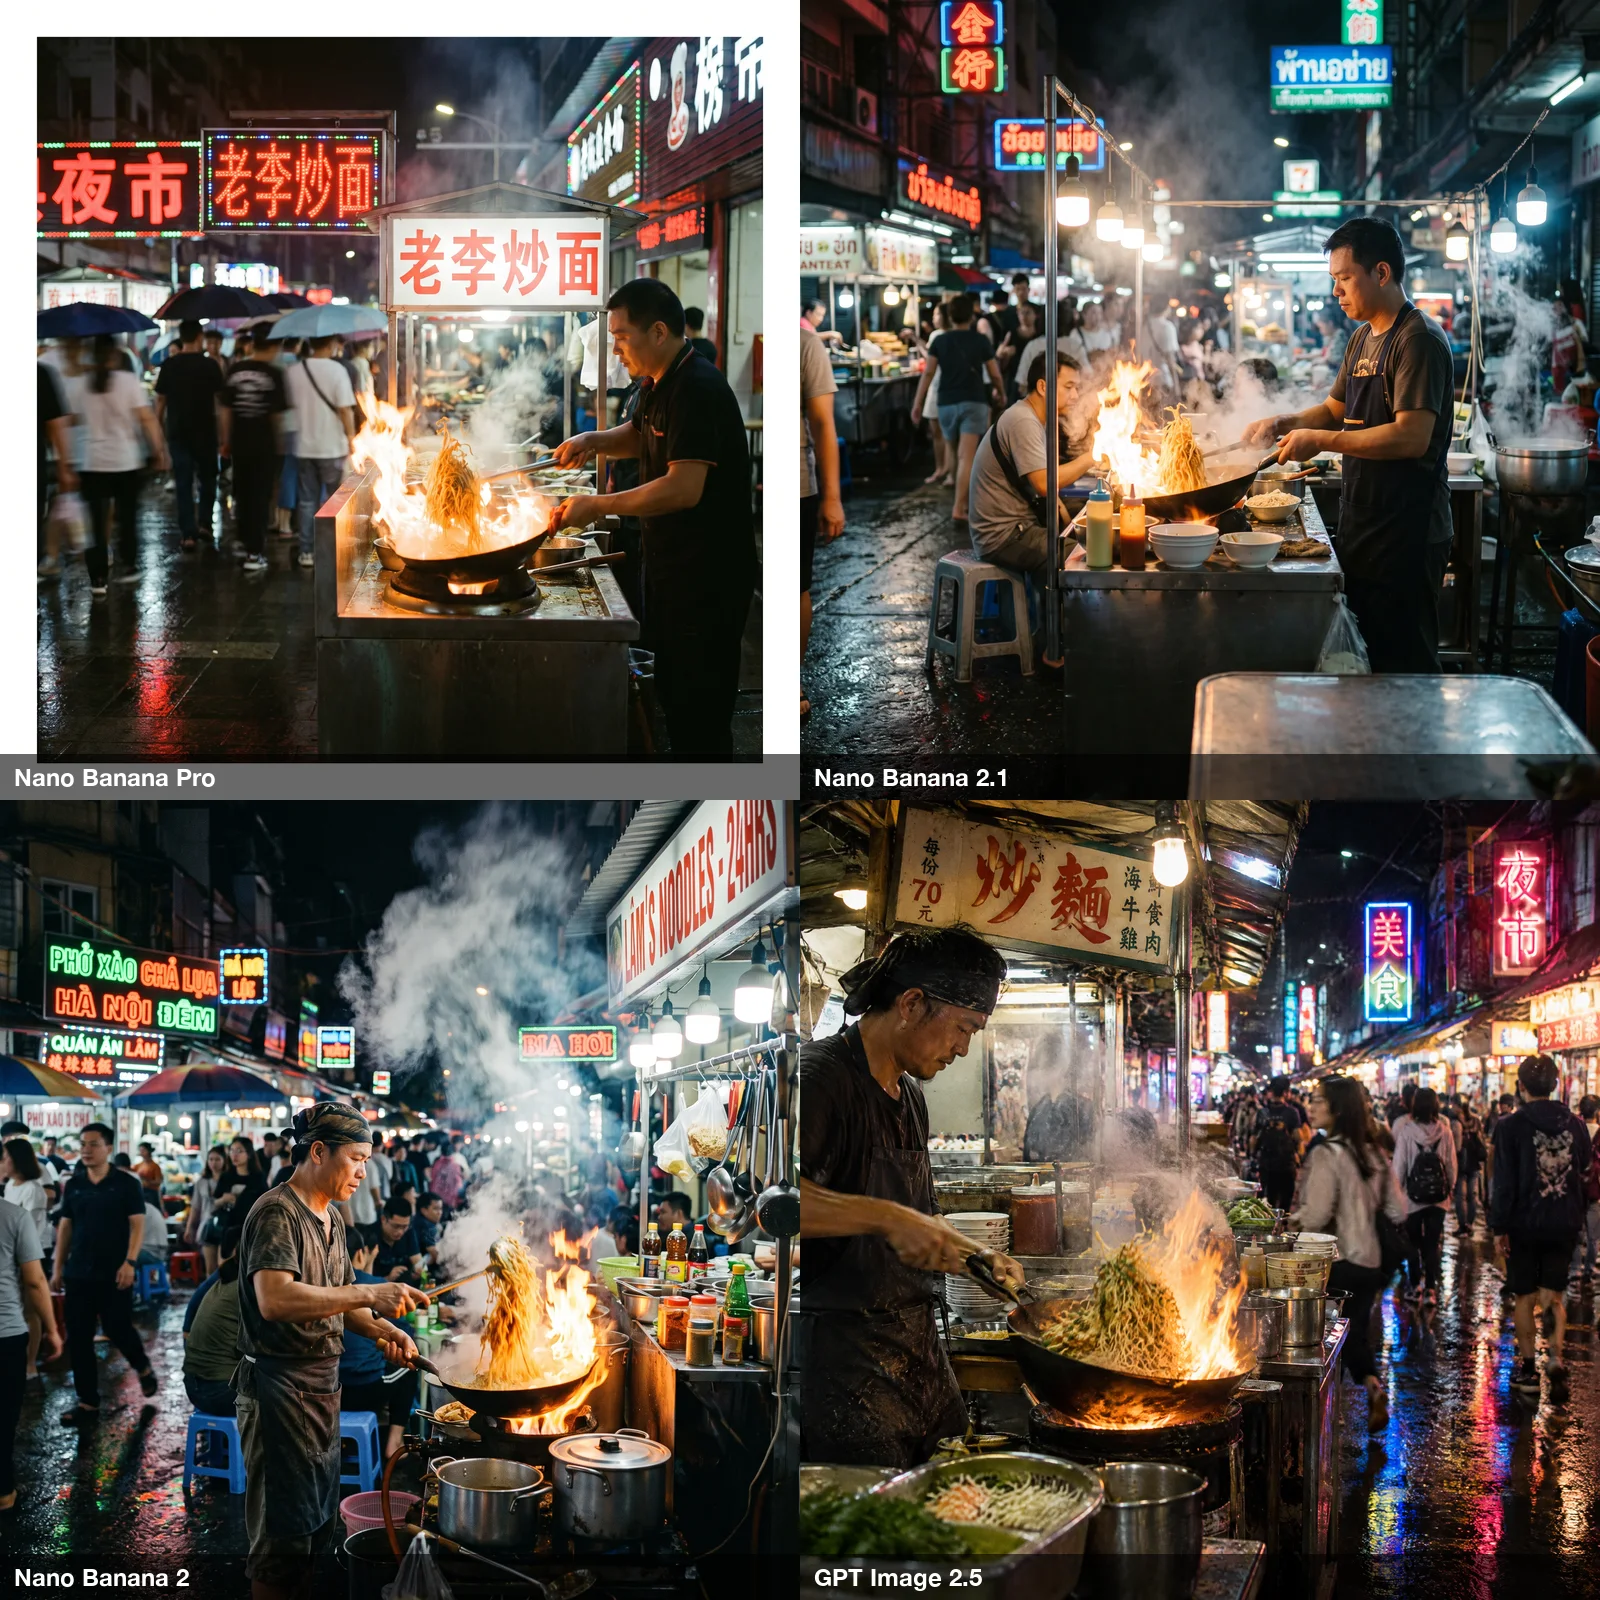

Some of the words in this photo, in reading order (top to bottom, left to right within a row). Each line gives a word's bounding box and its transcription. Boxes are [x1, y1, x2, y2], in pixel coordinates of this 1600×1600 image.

[37, 151, 188, 224] 夜市
[214, 142, 373, 218] 老李炒面
[399, 228, 601, 296] 老李炒面
[658, 826, 715, 958] NOODLES
[726, 800, 777, 904] 24HRS
[971, 835, 1112, 944] 炒麵
[1498, 850, 1541, 965] 夜市
[50, 942, 94, 976] PHỞ
[96, 950, 137, 984] XÀO
[140, 956, 180, 990] CHẢ
[182, 968, 218, 999] LỤA
[1370, 912, 1406, 1009] 美食
[51, 1033, 98, 1054] QUÁN
[55, 984, 97, 1018] HÀ
[103, 991, 152, 1029] NỘI
[157, 999, 215, 1032] ĐÊM
[522, 1034, 565, 1056] BIA
